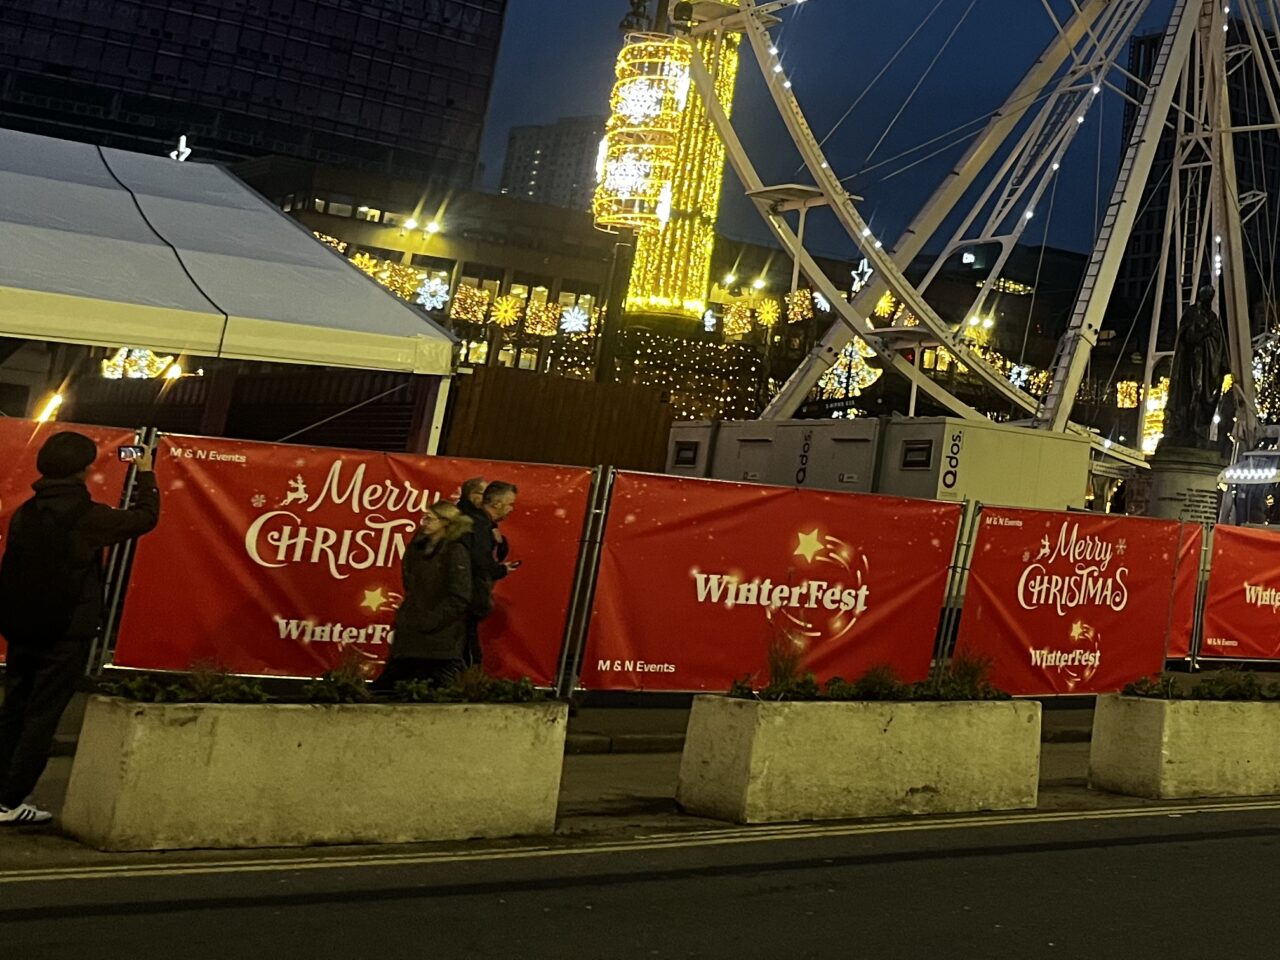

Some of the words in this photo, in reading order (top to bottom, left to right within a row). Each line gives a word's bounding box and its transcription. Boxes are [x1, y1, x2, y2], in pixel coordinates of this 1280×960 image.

[170, 447, 183, 458] M
[184, 448, 193, 458] &
[196, 450, 208, 460] N
[209, 450, 247, 463] Events
[1048, 521, 1113, 571] Merry
[693, 573, 869, 612] WinterFest
[1017, 563, 1129, 616] CHRISTMAS
[597, 660, 610, 671] M
[613, 660, 622, 671] &
[624, 661, 634, 672] N
[636, 661, 675, 673] Events
[1031, 649, 1101, 668] WinterFest
